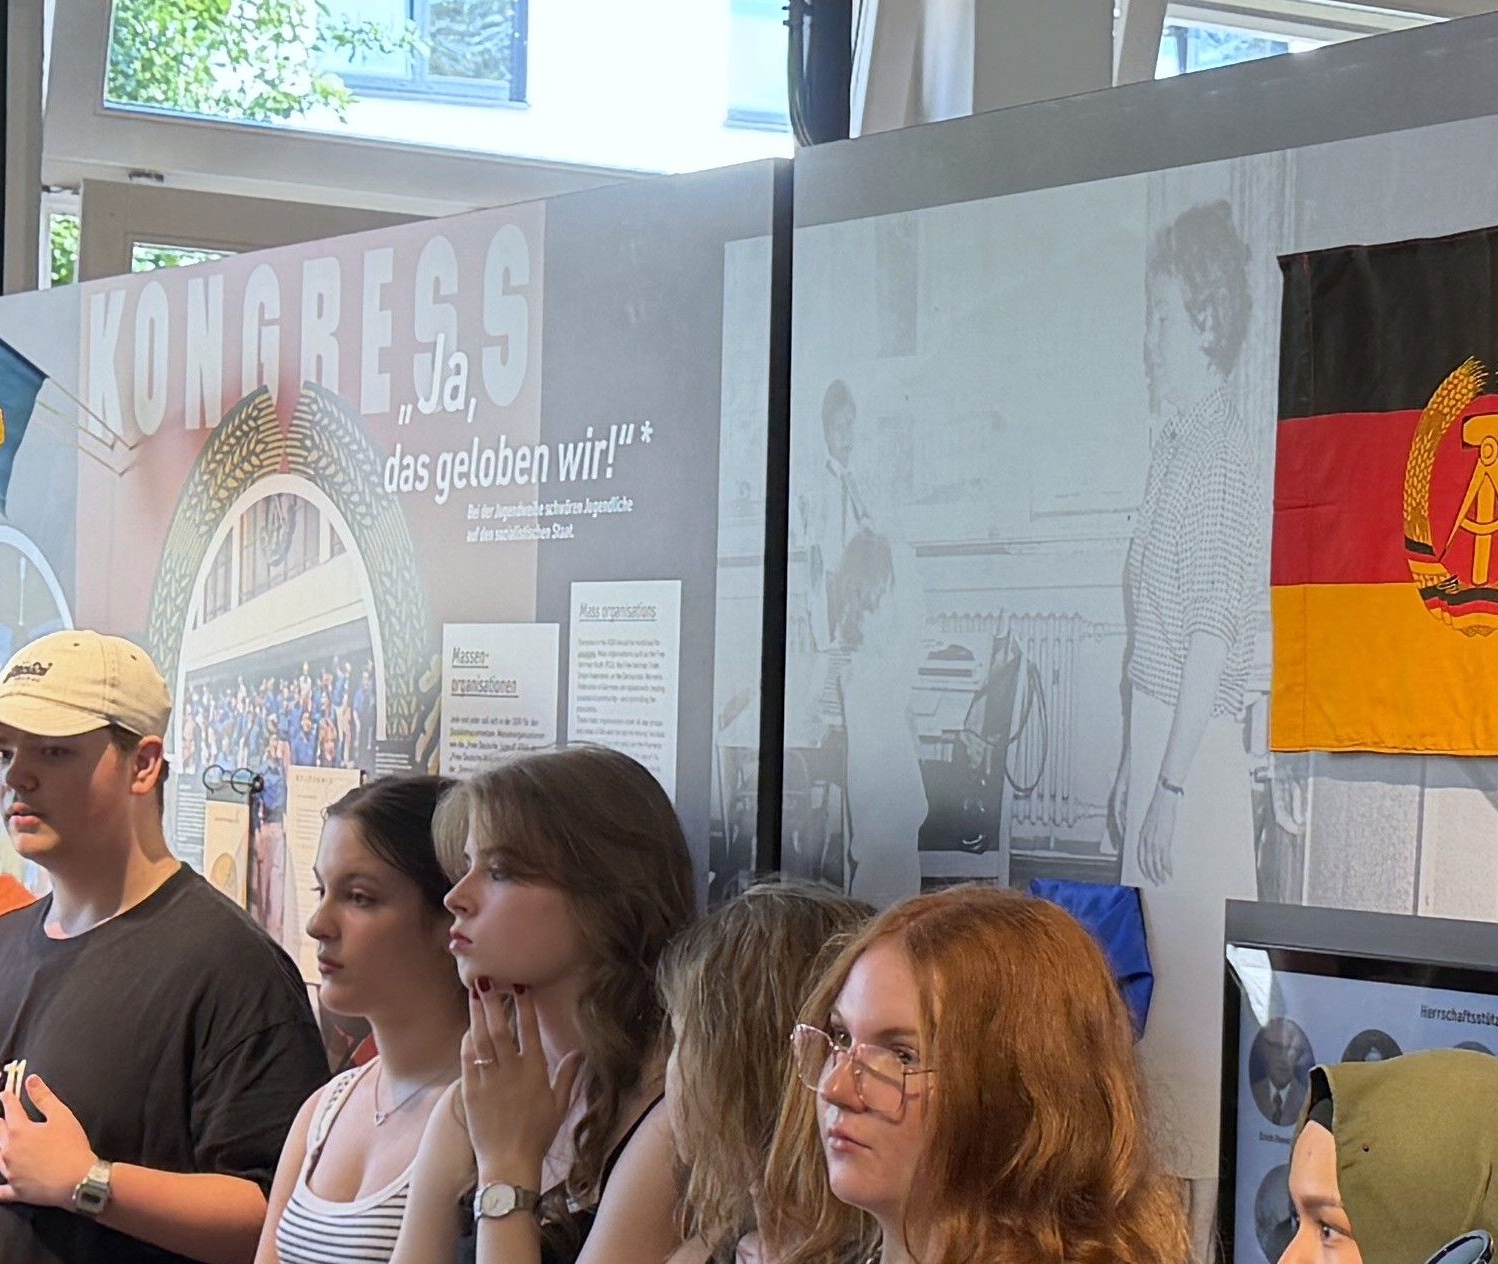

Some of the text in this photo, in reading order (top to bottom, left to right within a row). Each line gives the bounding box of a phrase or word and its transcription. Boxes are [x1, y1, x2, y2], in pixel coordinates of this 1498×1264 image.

[87, 223, 530, 437] KONGRESS
[384, 443, 430, 494] das
[435, 435, 549, 505] geloben
